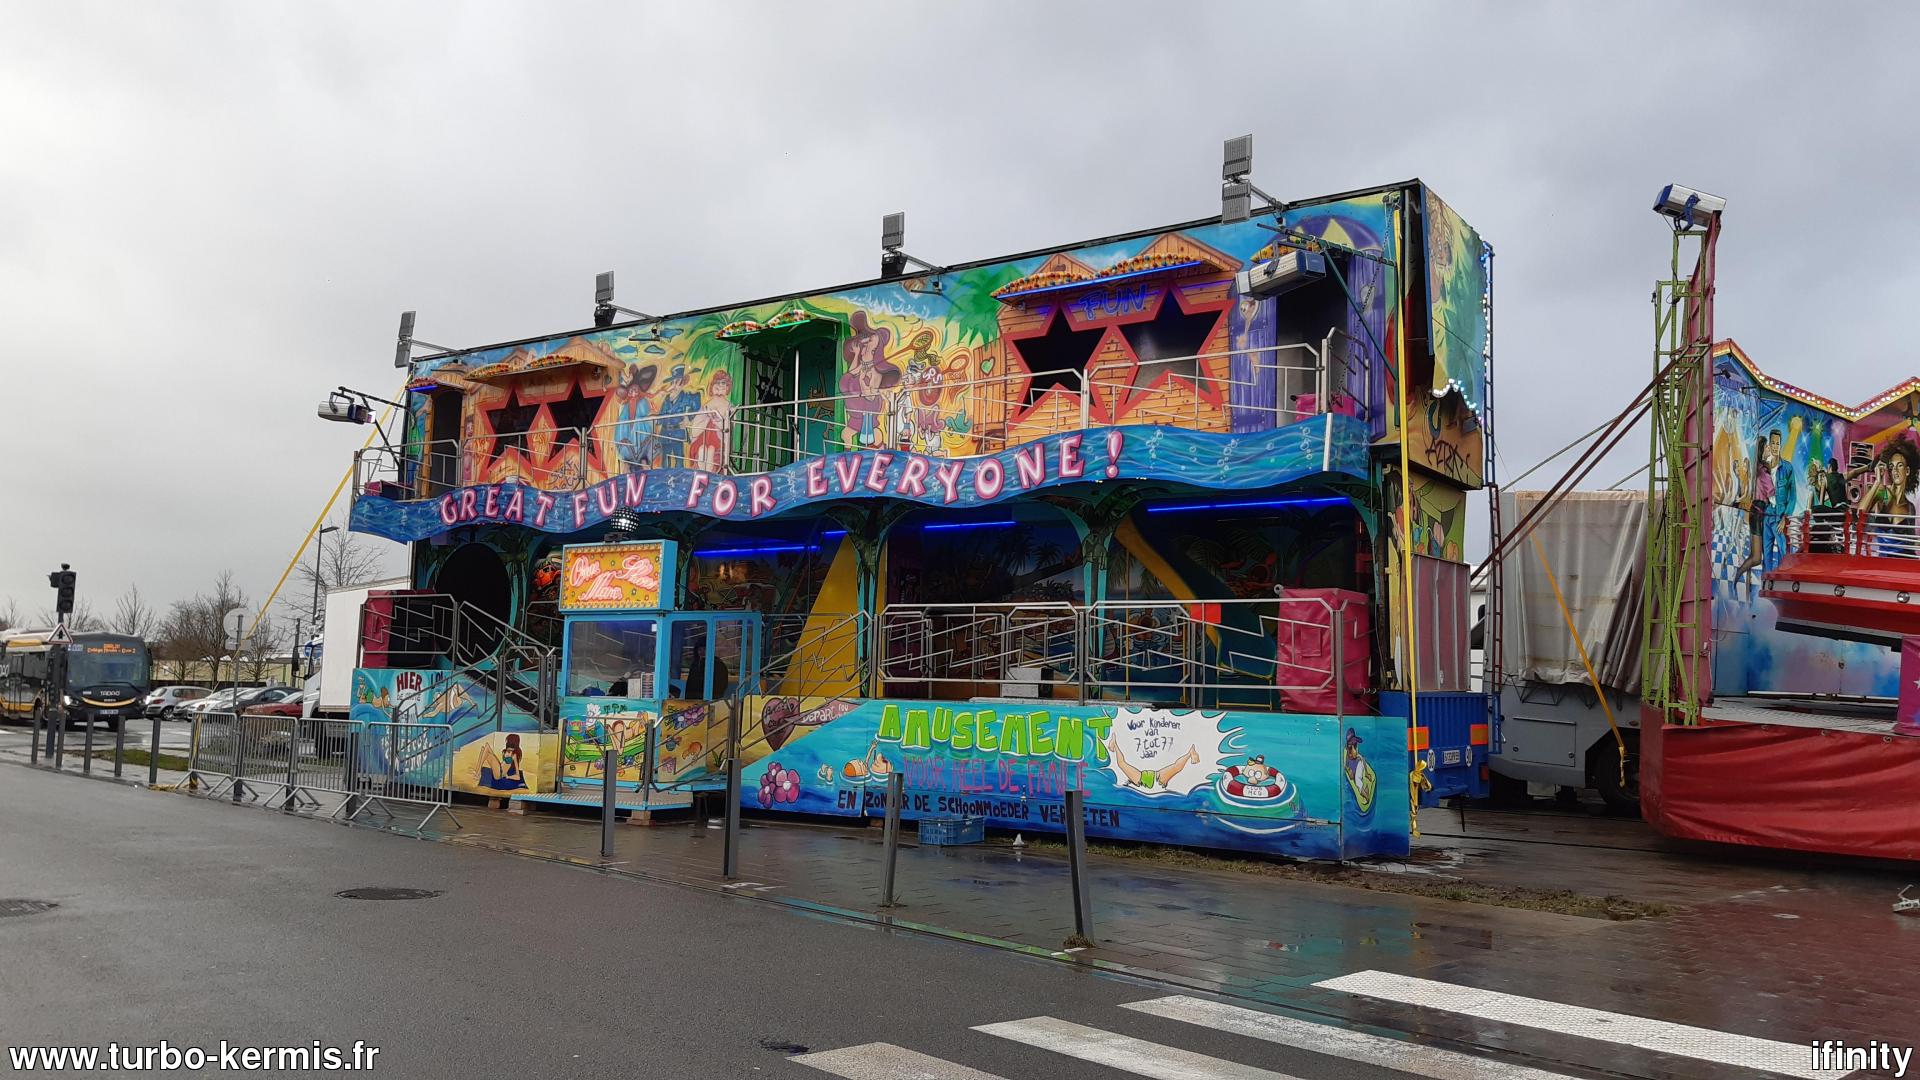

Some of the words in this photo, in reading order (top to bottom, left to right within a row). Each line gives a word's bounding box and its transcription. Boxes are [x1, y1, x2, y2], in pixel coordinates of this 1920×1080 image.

[1079, 283, 1148, 320] FUN
[922, 367, 943, 384] SOS
[440, 483, 555, 527] GREAT
[573, 472, 647, 529] FUN
[686, 473, 777, 519] FOR
[396, 671, 423, 692] HIER
[878, 703, 1113, 762] AMUSEMENT
[1144, 728, 1159, 736] van
[1134, 737, 1142, 752] 7
[903, 755, 946, 790] VOOR
[952, 758, 993, 792] HEEL
[998, 759, 1020, 793] DE
[837, 790, 857, 810] EN
[914, 793, 931, 813] DE
